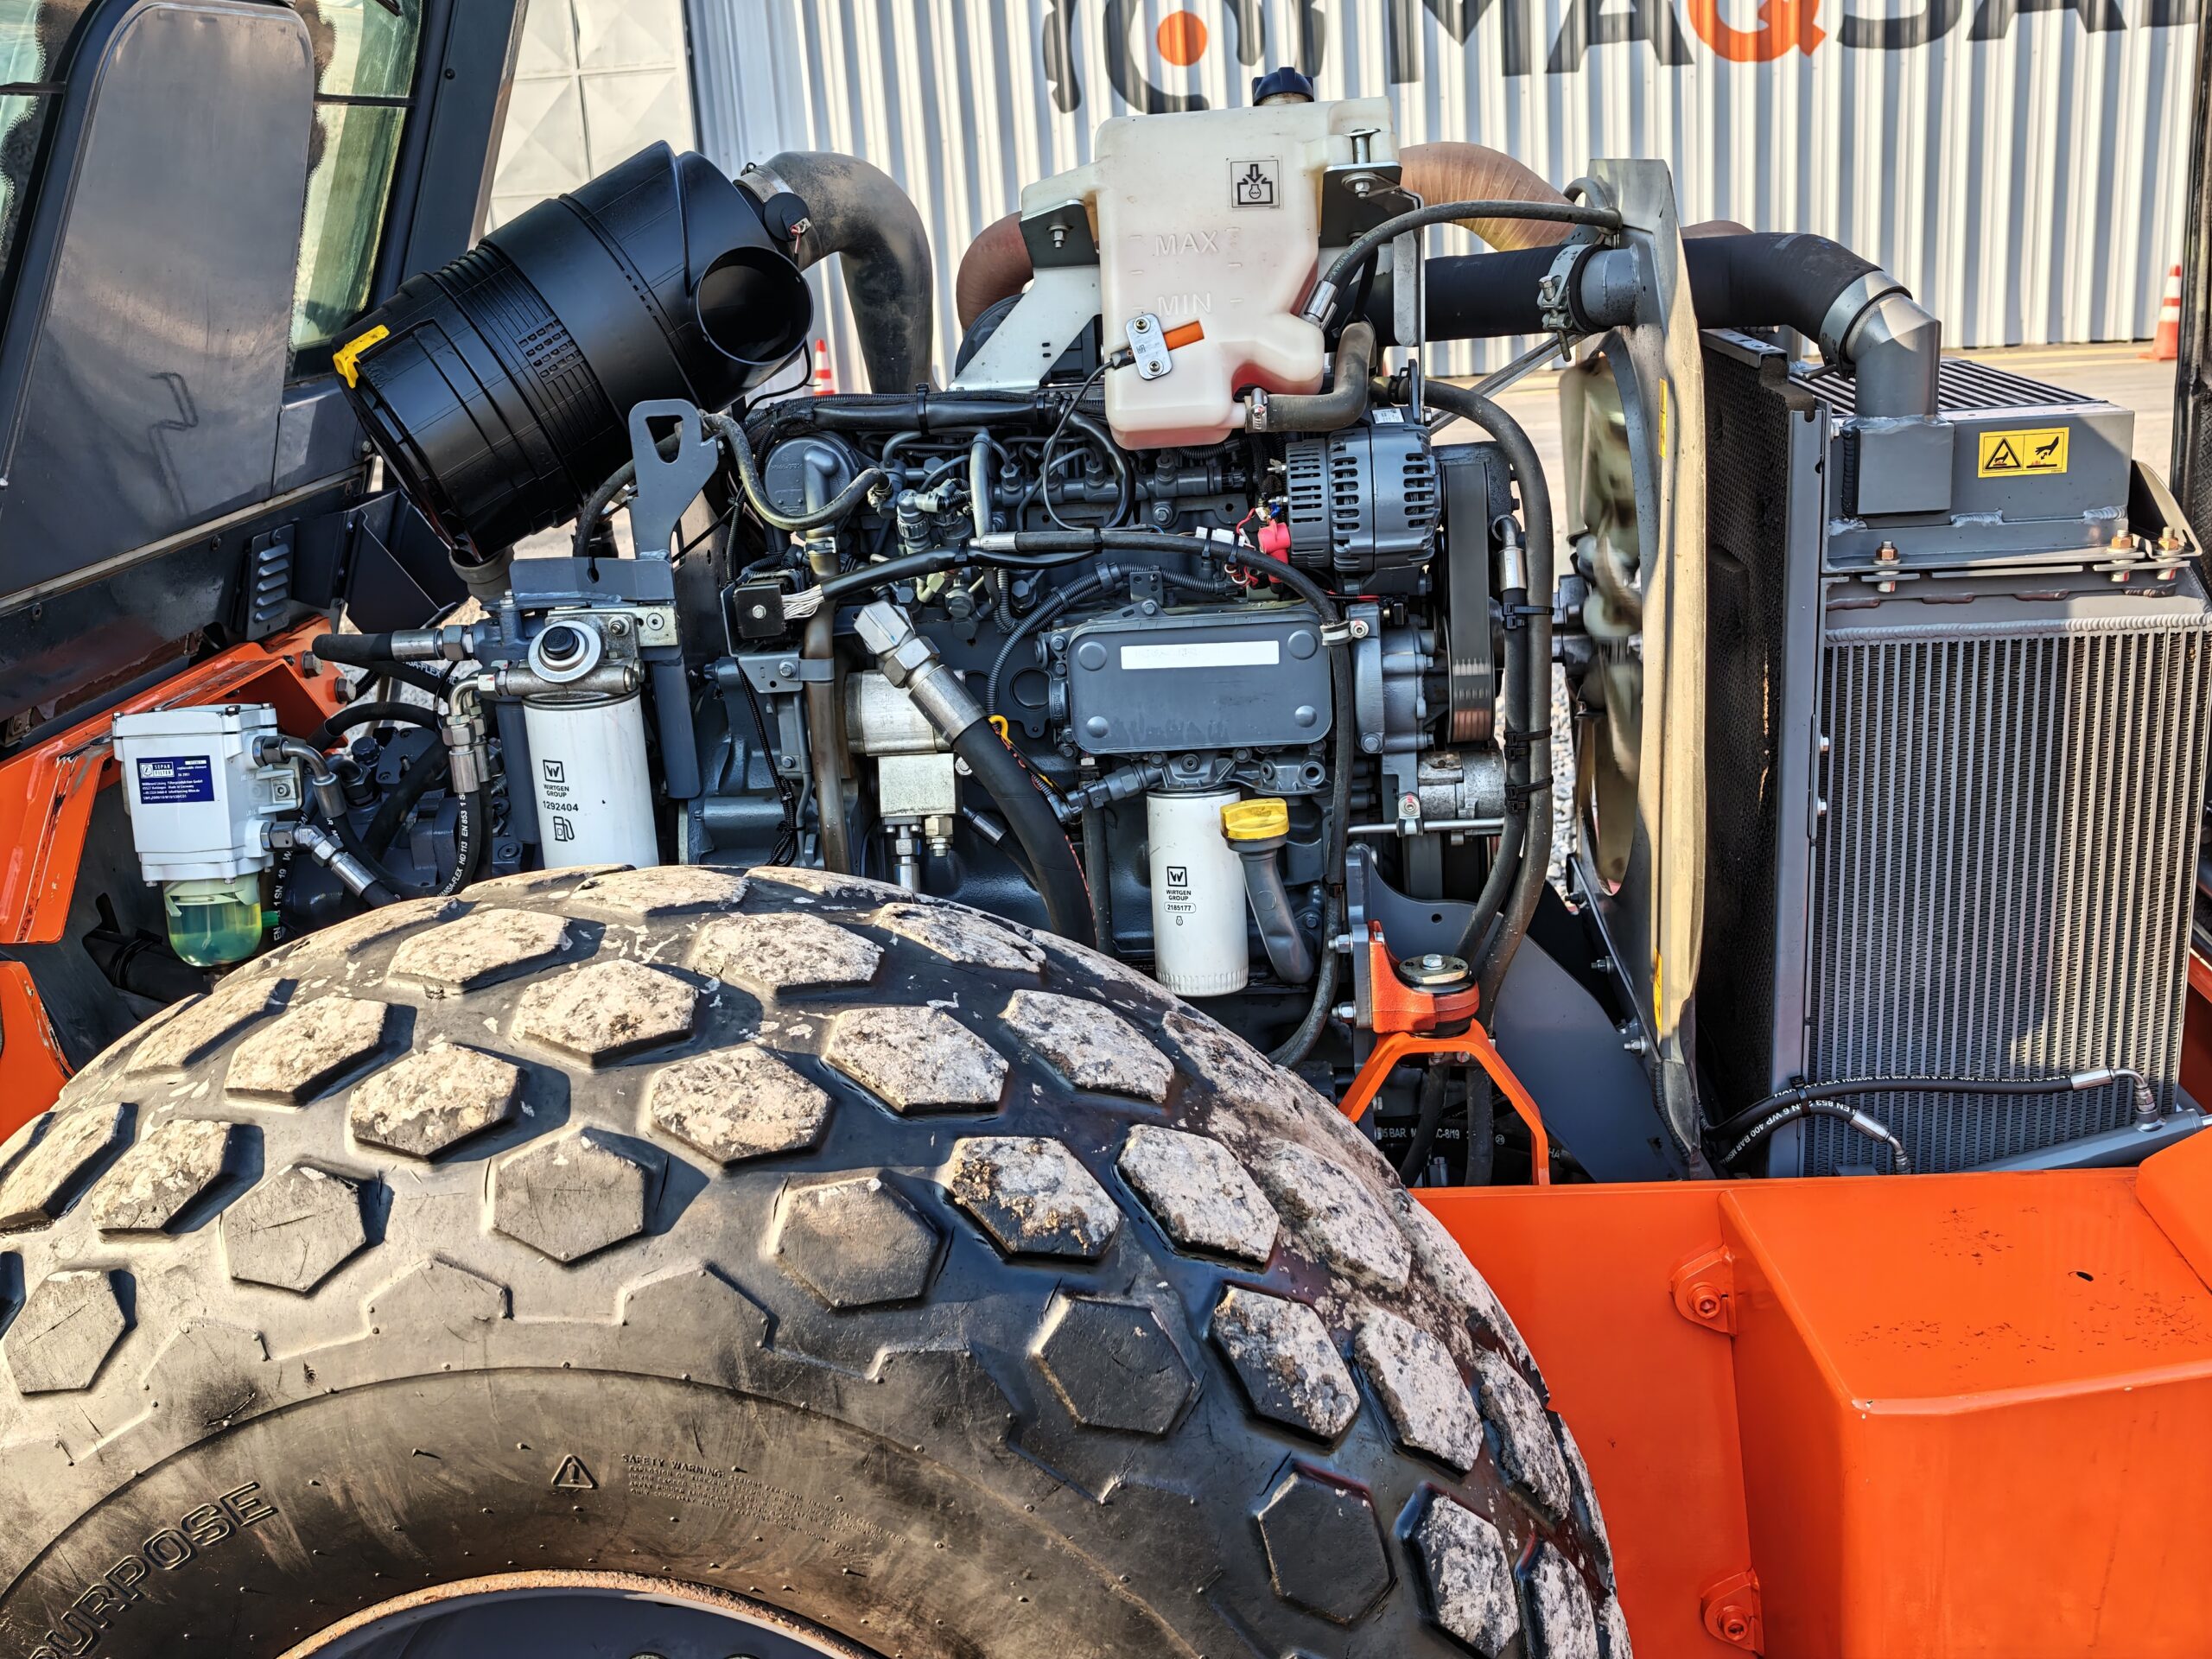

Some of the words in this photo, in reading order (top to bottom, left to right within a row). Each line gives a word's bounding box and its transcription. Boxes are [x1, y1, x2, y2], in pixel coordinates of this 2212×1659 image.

[1389, 0, 2200, 84] MAQ
[1155, 230, 1219, 257] MAX
[1332, 259, 1344, 276] ITALY
[1157, 293, 1211, 317] MIN
[543, 800, 579, 811] 1292404
[461, 824, 468, 837] EN
[283, 849, 294, 861] W
[459, 853, 467, 866] HD
[278, 868, 287, 879] 19
[275, 886, 283, 899] SN
[273, 928, 282, 941] EN
[1774, 1079, 1840, 1098] HANA-FLEX
[1792, 1100, 1813, 1111] 2N
[1836, 1102, 1850, 1113] EN
[1767, 1112, 1782, 1125] WP
[1389, 1128, 1407, 1138] BAR
[1750, 1122, 1765, 1138] 400
[1734, 1134, 1751, 1152] BAR
[622, 1453, 665, 1467] SAFETY
[671, 1460, 725, 1478] WARNING:
[29, 1481, 279, 1659] URPOSE
